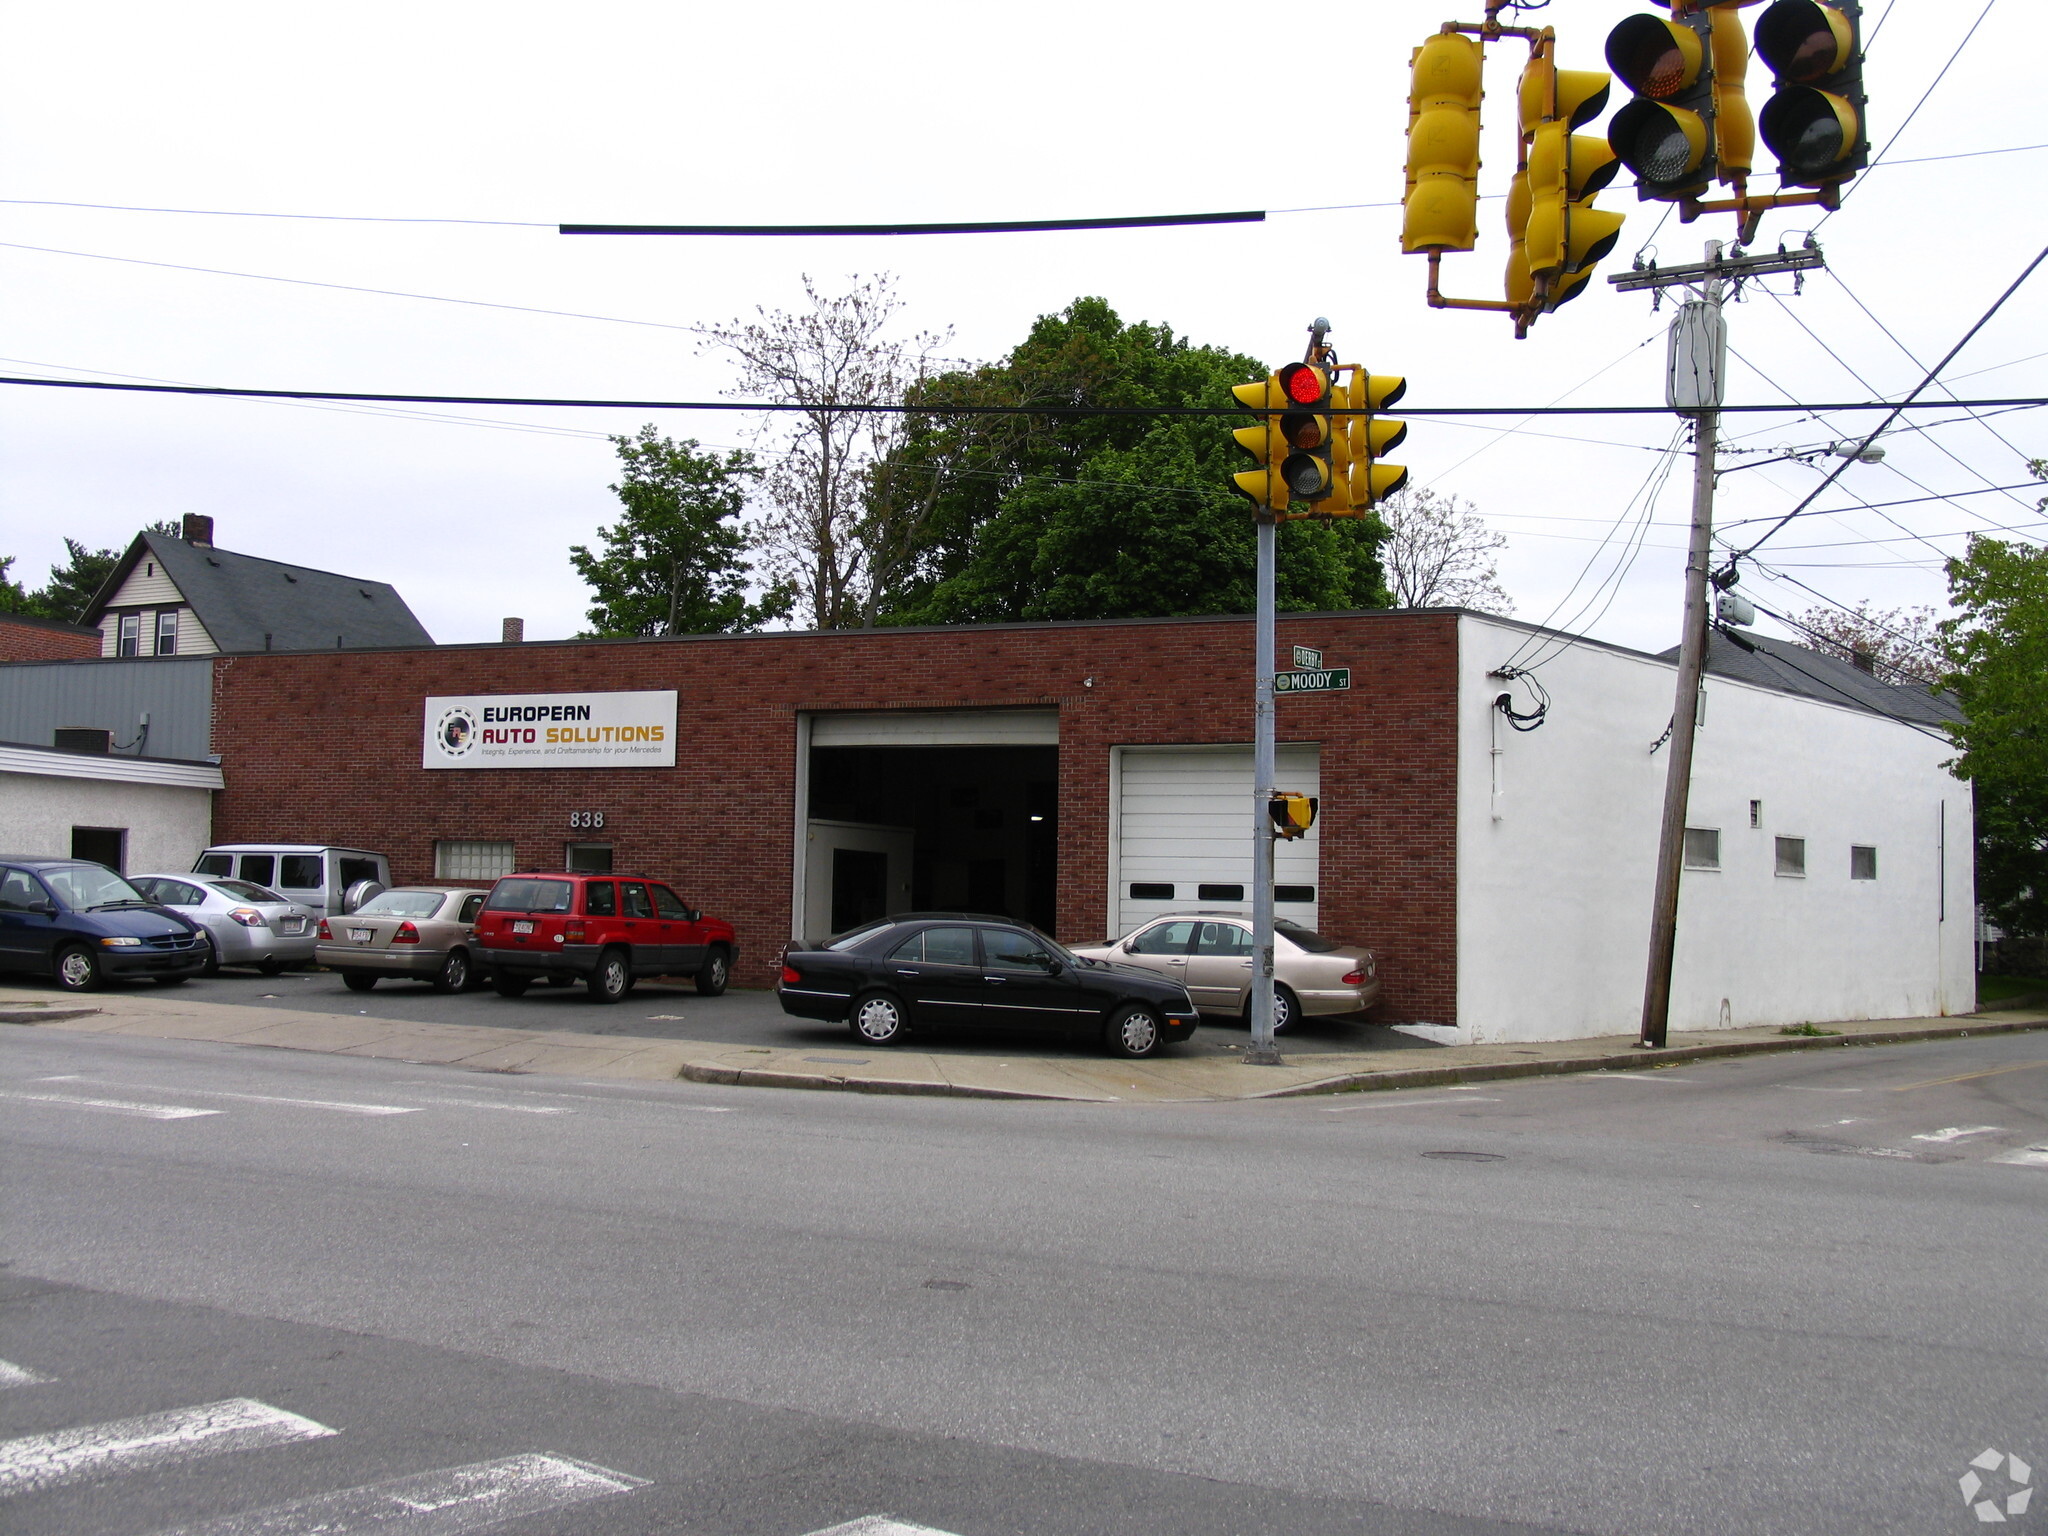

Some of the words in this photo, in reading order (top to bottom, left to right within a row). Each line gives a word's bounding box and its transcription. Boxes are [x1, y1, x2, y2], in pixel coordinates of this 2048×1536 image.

[1291, 672, 1332, 689] MOODY
[1339, 678, 1347, 687] ST
[484, 705, 590, 722] EUROPEAN
[483, 729, 536, 744] AUTO
[546, 726, 664, 743] SOLUTIONS
[557, 747, 602, 755] Craftsmanship
[615, 747, 628, 755] your
[571, 811, 604, 828] 838
